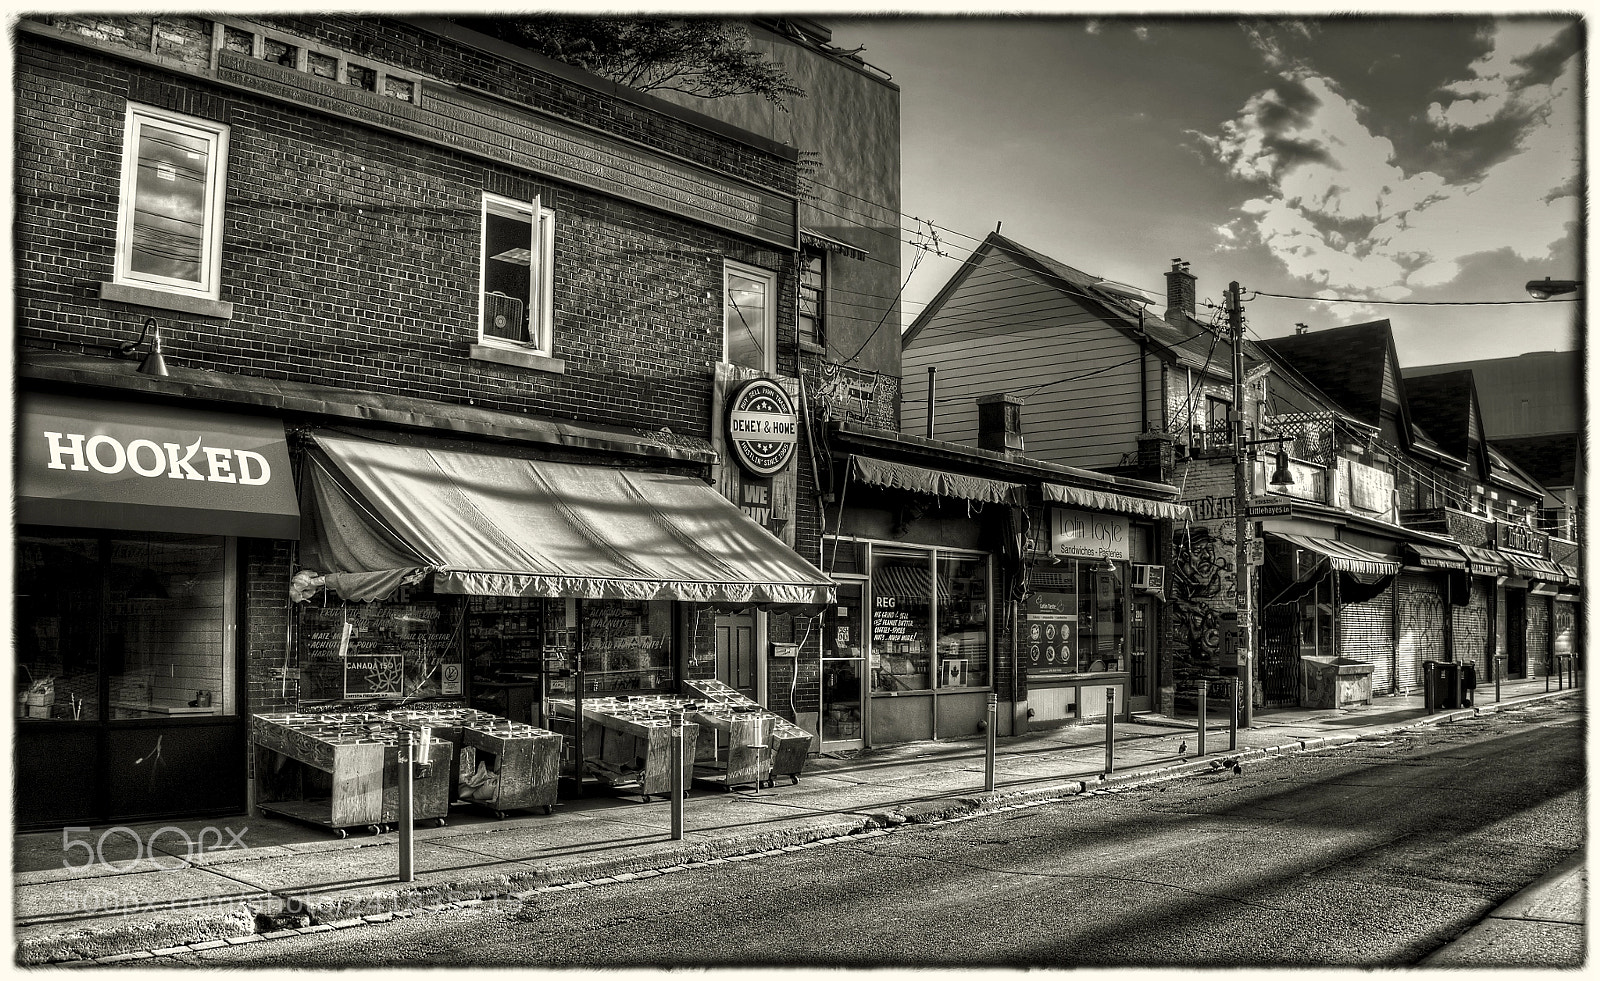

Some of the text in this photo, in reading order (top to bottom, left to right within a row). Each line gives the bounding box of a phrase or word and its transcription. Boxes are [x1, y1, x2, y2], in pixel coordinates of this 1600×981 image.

[749, 388, 761, 399] SELL
[762, 388, 775, 397] PAWN
[775, 394, 788, 413] TRADE
[733, 419, 796, 435] DEWEY & HOWE
[44, 431, 271, 486] HOOKED
[763, 455, 779, 466] SINCE
[744, 484, 768, 505] WE
[740, 505, 771, 526] BUY
[1060, 510, 1123, 550] Latin Taste
[1060, 543, 1095, 557] Sandwiches
[876, 597, 896, 608] REG
[311, 632, 330, 640] MAIZ
[357, 640, 378, 649] POLVO
[346, 662, 394, 670] CANADA 150
